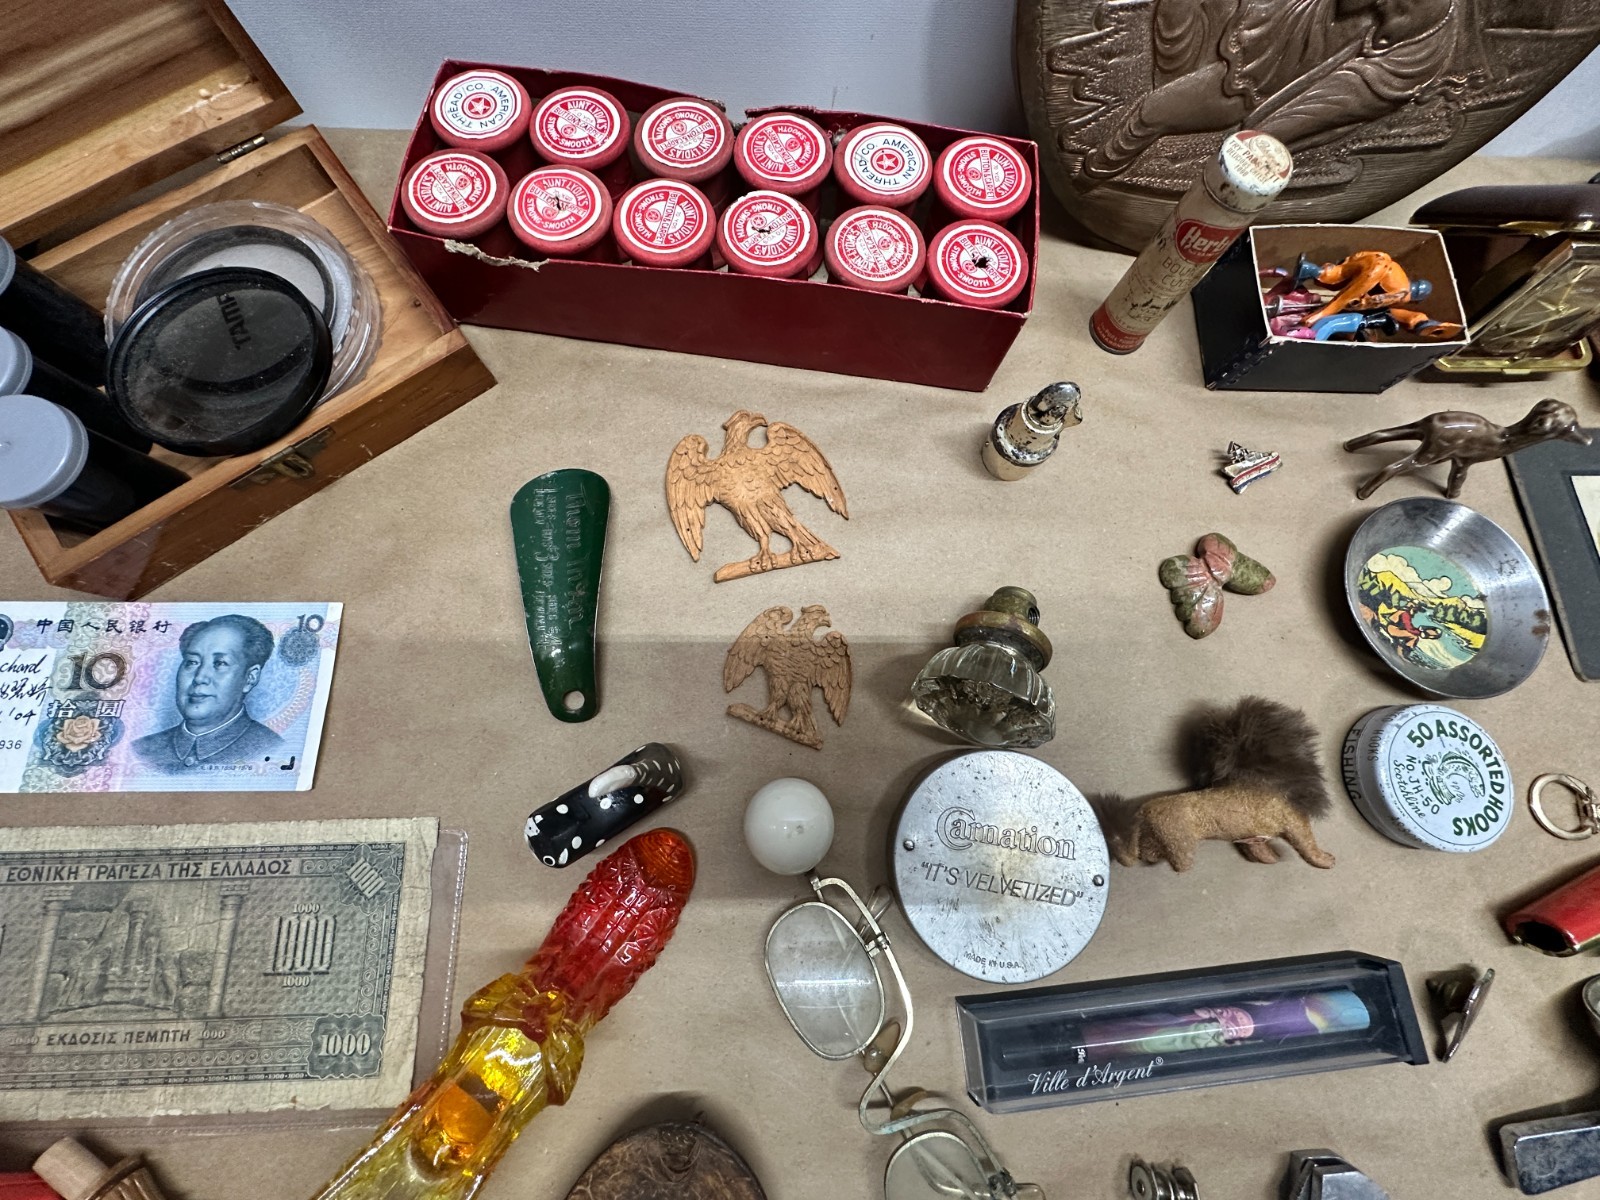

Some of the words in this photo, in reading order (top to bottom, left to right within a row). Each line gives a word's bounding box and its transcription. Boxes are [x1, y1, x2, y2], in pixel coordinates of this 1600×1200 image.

[450, 92, 473, 129] THREAD
[480, 86, 510, 129] AMERICAN
[567, 100, 592, 112] AUNT
[702, 133, 715, 154] AUNT
[861, 142, 878, 156] CO.
[1229, 140, 1244, 152] TRY
[761, 159, 784, 172] AUNT
[882, 138, 917, 180] AMERICAN
[993, 152, 1014, 170] AUNT
[859, 159, 900, 186] THREAD
[996, 170, 1016, 197] LYDIA'S
[542, 178, 568, 190] AUNT
[566, 181, 589, 208] LYDIA'S
[430, 200, 453, 213] AUNT
[679, 200, 697, 221] AUNT
[667, 221, 696, 244] LYDIA'S
[786, 225, 798, 247] AUNT
[975, 235, 1000, 249] AUNT
[36, 618, 173, 634] 中国人民银行
[296, 614, 325, 633] 10
[59, 652, 127, 691] 10
[1367, 729, 1385, 762] HOOKS
[1406, 721, 1434, 748] 50
[1342, 728, 1362, 801] FISHING
[1405, 754, 1418, 775] No.
[1435, 719, 1506, 795] ASSORTED
[1393, 759, 1426, 819] Scotchline
[1408, 774, 1440, 815] JH-50
[1452, 794, 1505, 837] HOOKS
[936, 806, 1076, 861] Carnation
[6, 865, 79, 883] ΕΘΝΙΚΗ
[86, 863, 162, 881] ΤΡΑΠΕΖΑ
[167, 861, 203, 879] ΤΗΣ
[209, 859, 293, 877] ΕΛΛΑΔΟΣ
[293, 903, 321, 914] 1000
[963, 951, 987, 966] MADE
[281, 976, 311, 988] 1000
[46, 1032, 117, 1046] ΕΚΔΟΣΙΣ
[123, 1029, 191, 1043] ΠΕΜΠΤΗ
[318, 1034, 371, 1057] 1000
[1027, 1068, 1069, 1095] Ville
